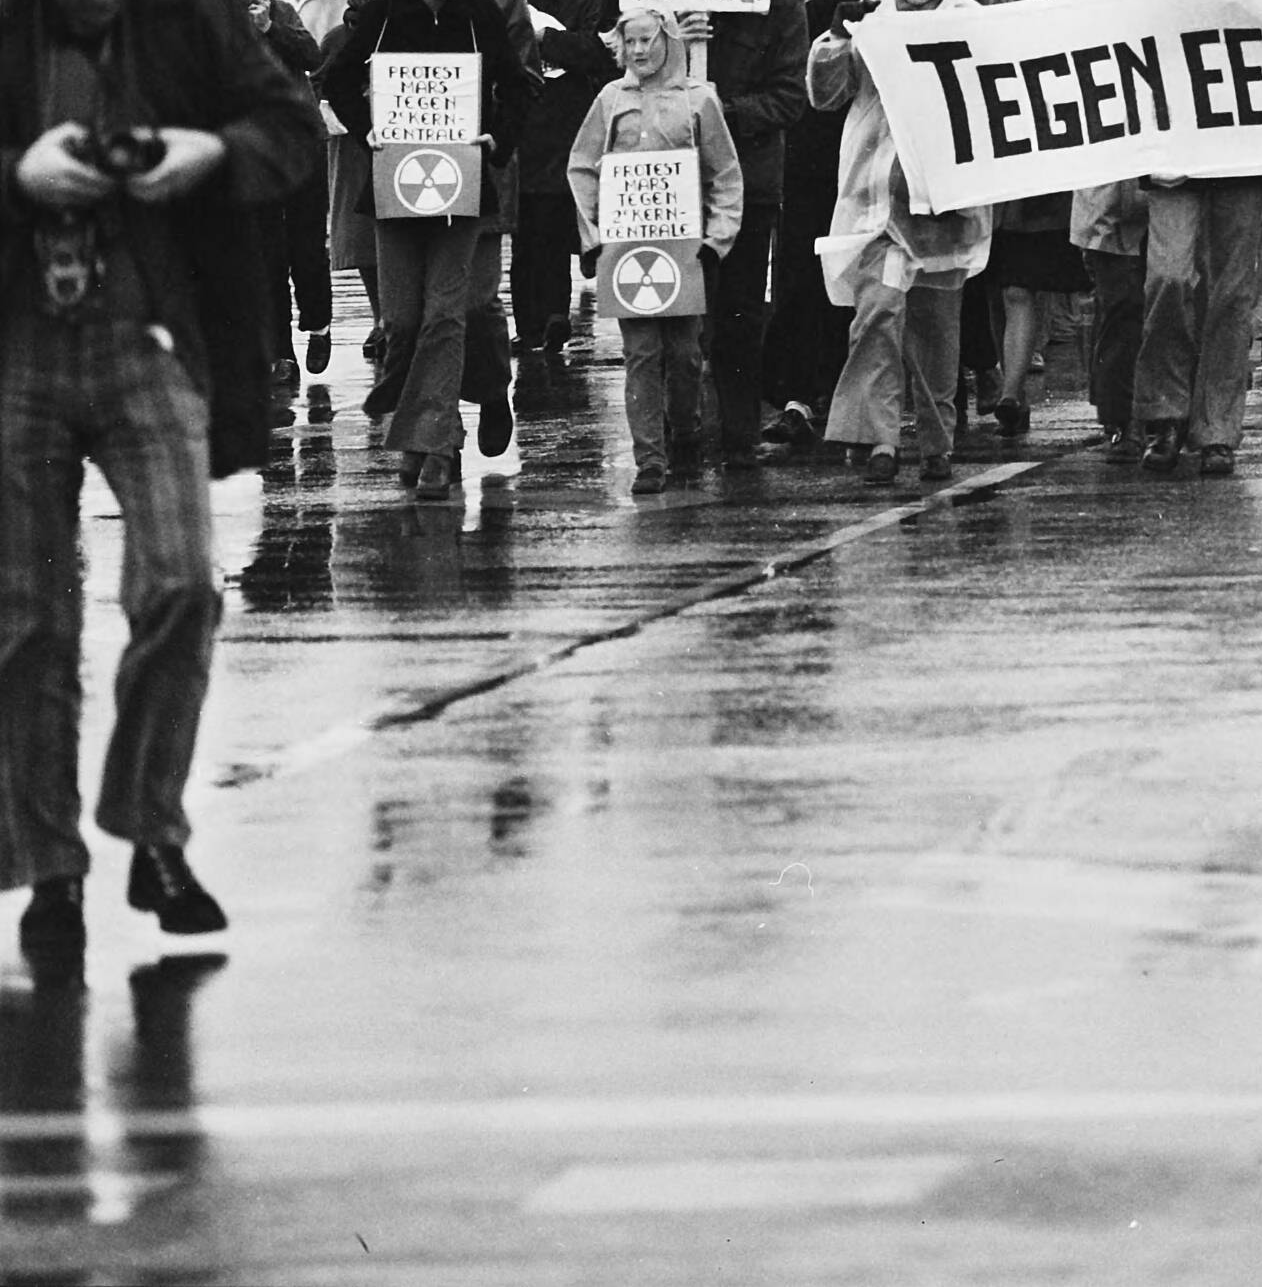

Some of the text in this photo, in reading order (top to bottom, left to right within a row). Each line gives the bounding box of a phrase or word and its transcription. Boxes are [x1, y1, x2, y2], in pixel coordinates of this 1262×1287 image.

[388, 66, 461, 80] PROTEST
[401, 81, 448, 94] MARS
[394, 95, 456, 110] TEGEN
[906, 35, 1170, 164] TEGEN
[409, 112, 464, 126] KERN-
[381, 127, 467, 141] CENTRALE
[613, 161, 682, 178] PROTEST
[625, 177, 669, 192] MARS
[617, 191, 678, 206] TEGEN
[632, 207, 686, 222] KERN-
[606, 223, 689, 239] CENTRALE
